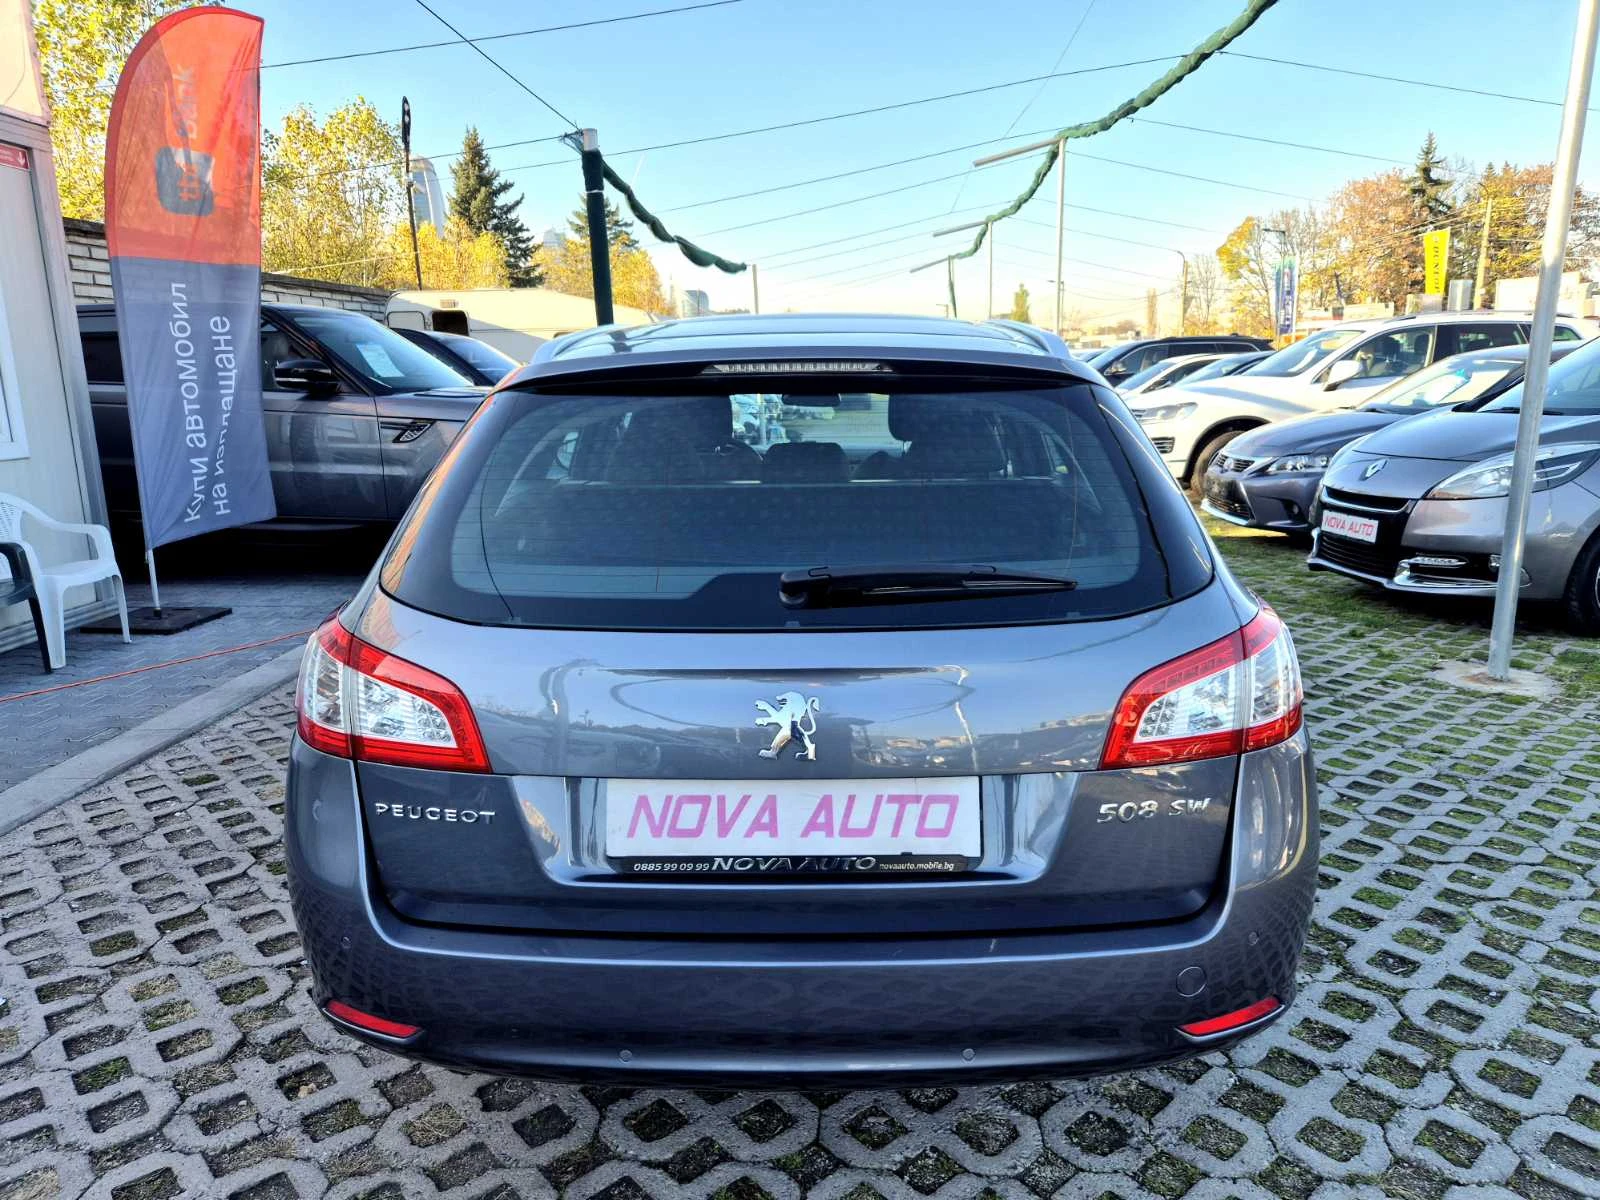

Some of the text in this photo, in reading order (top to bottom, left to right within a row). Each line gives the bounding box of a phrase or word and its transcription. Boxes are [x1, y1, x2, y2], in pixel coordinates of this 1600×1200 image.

[168, 283, 209, 522] Купи автомобил
[212, 482, 231, 515] на
[1325, 516, 1375, 536] NOVA AUTO
[374, 802, 496, 824] PEUGEOT
[626, 794, 960, 839] NOVA AUTO
[1096, 797, 1211, 823] 508 SW
[633, 856, 955, 871] 0885 99 09 99 NOVA AUTO novaauto.mobile.bg
